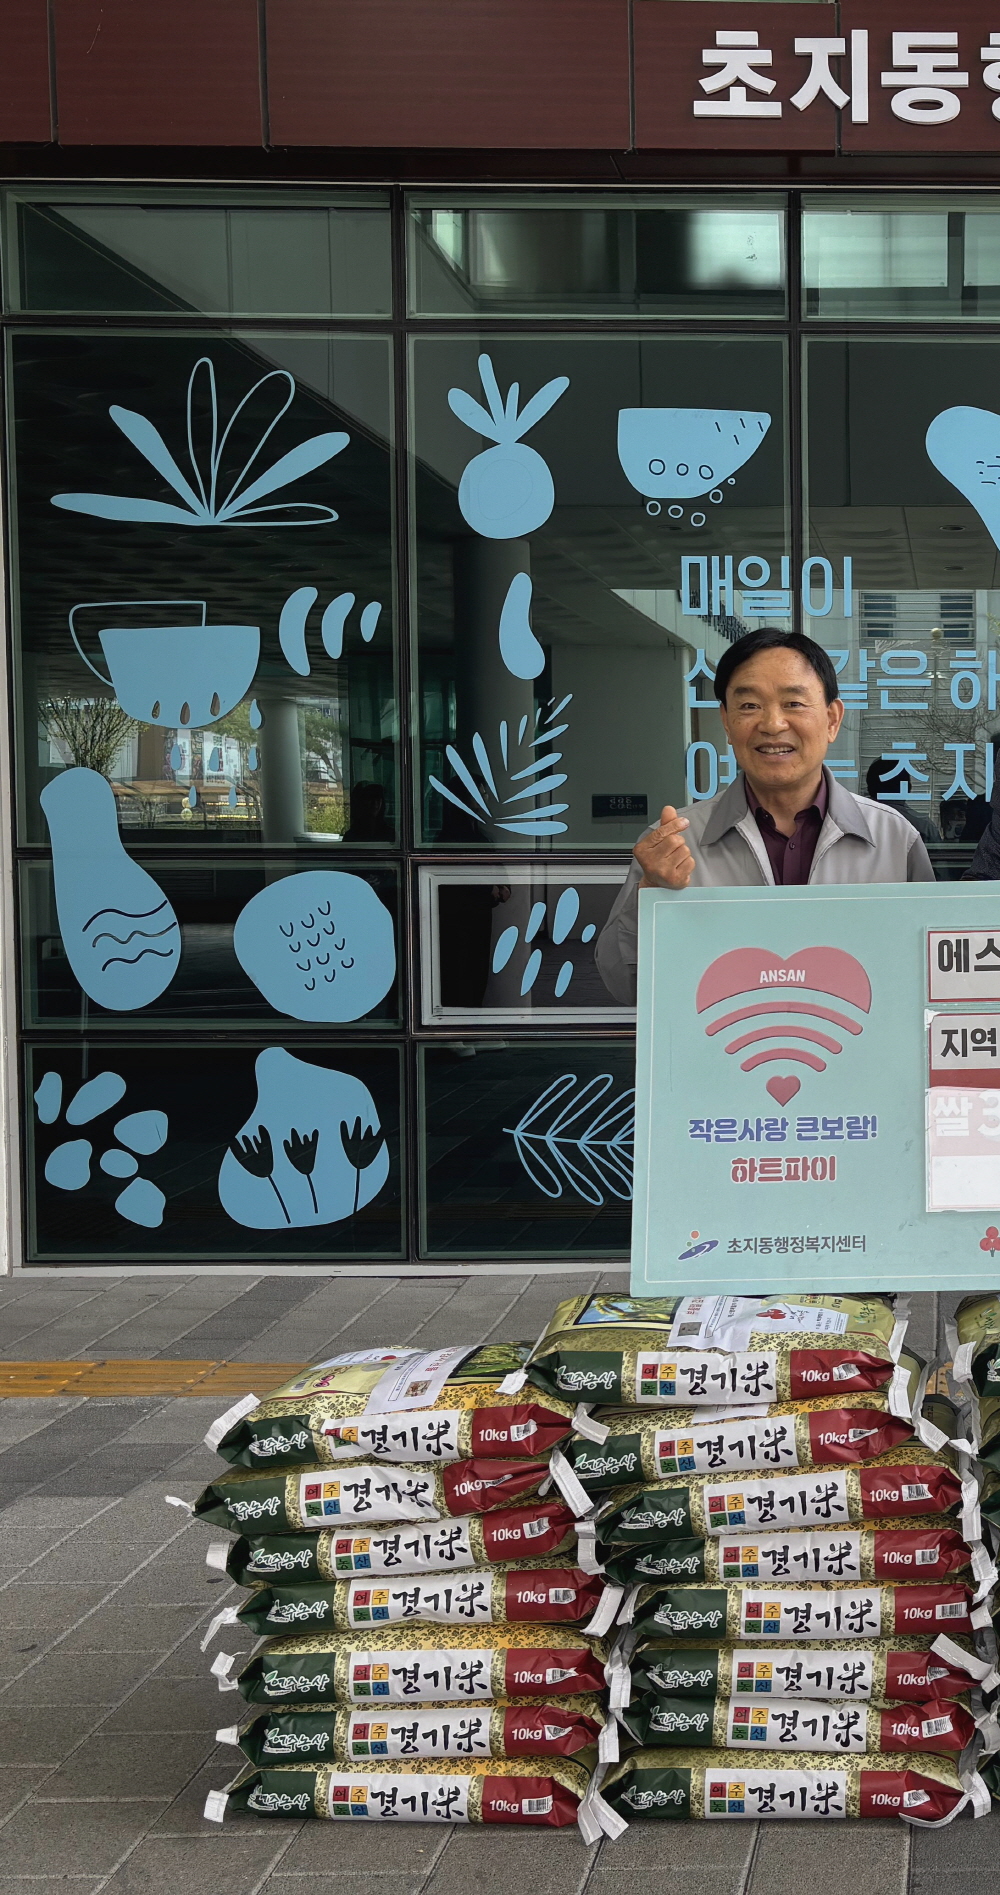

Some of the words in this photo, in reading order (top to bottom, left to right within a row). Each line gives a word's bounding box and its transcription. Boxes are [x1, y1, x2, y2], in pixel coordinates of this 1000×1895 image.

[681, 555, 852, 617] 매일이
[759, 969, 806, 984] ANSAN
[933, 1096, 972, 1137] 쌀
[689, 1116, 789, 1143] 작은사랑
[795, 1115, 877, 1141] 큰보람!
[731, 1155, 836, 1182] 하트파이
[726, 1234, 867, 1255] 초지동행정복지센터
[644, 1365, 675, 1378] 여주
[800, 1368, 830, 1383] 10kg
[644, 1382, 674, 1394] 농산
[478, 1428, 508, 1442] 10kg
[818, 1432, 848, 1446] 10kg
[661, 1441, 693, 1455] 여주
[581, 1453, 637, 1475] 여주농산
[662, 1458, 694, 1471] 농산
[307, 1483, 338, 1498] 여주
[453, 1480, 483, 1498] 10kg
[710, 1495, 742, 1509] 여주
[869, 1489, 899, 1504] 10kg
[307, 1501, 339, 1515] 농산
[712, 1513, 744, 1526] 농산
[491, 1528, 521, 1542] 10kg
[337, 1539, 368, 1552] 여주
[725, 1548, 756, 1561] 여주
[881, 1551, 913, 1565] 10kg
[337, 1556, 369, 1569] 농산
[725, 1565, 756, 1576] 농산
[356, 1591, 388, 1604] 여주
[515, 1590, 546, 1604] 10kg
[356, 1608, 388, 1619] 농산
[747, 1604, 779, 1617] 여주
[903, 1607, 933, 1621] 10kg
[747, 1621, 779, 1632] 농산
[355, 1665, 388, 1678] 여주
[739, 1663, 770, 1677] 여주
[271, 1674, 330, 1692] 여주농산
[512, 1671, 543, 1684] 10kg
[896, 1672, 926, 1686] 10kg
[355, 1682, 388, 1694] 농산
[739, 1681, 770, 1691] 농산
[735, 1709, 766, 1722] 여주
[354, 1724, 387, 1738] 여주
[511, 1727, 542, 1741] 10kg
[734, 1726, 766, 1739] 농산
[890, 1723, 920, 1736] 10kg
[272, 1732, 329, 1752] 여주농산
[354, 1742, 387, 1753] 농산
[334, 1788, 365, 1800] 여주
[711, 1784, 743, 1797] 여주
[489, 1800, 520, 1814] 10kg
[711, 1801, 743, 1812] 농산
[870, 1793, 901, 1807] 10kg
[335, 1804, 366, 1814] 농산
